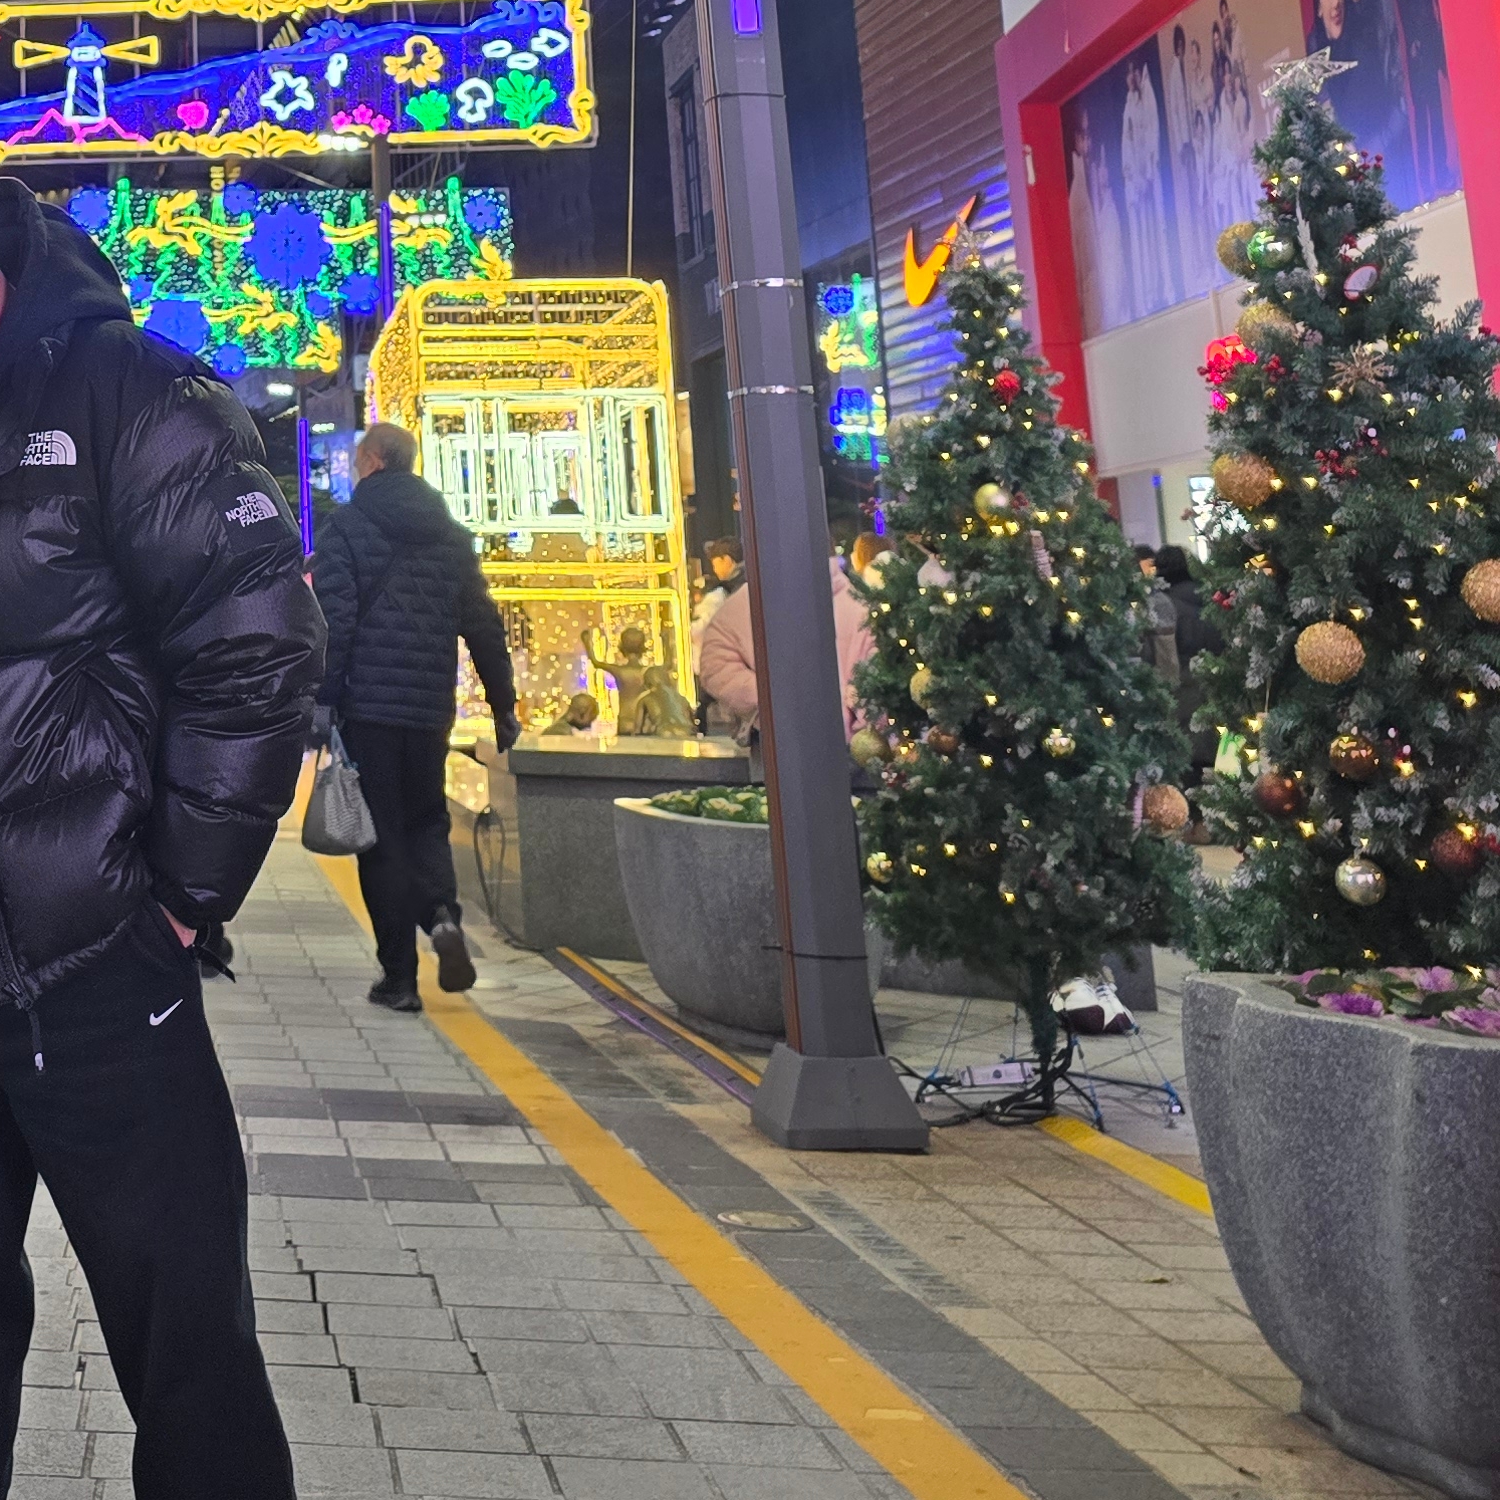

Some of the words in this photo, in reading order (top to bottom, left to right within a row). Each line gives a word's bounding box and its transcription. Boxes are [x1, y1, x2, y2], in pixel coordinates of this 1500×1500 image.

[28, 431, 53, 443] THE
[25, 442, 51, 454] RTH
[20, 454, 52, 466] FACE
[236, 493, 257, 506] THE
[225, 502, 260, 521] NORTH
[240, 510, 266, 527] FACE
